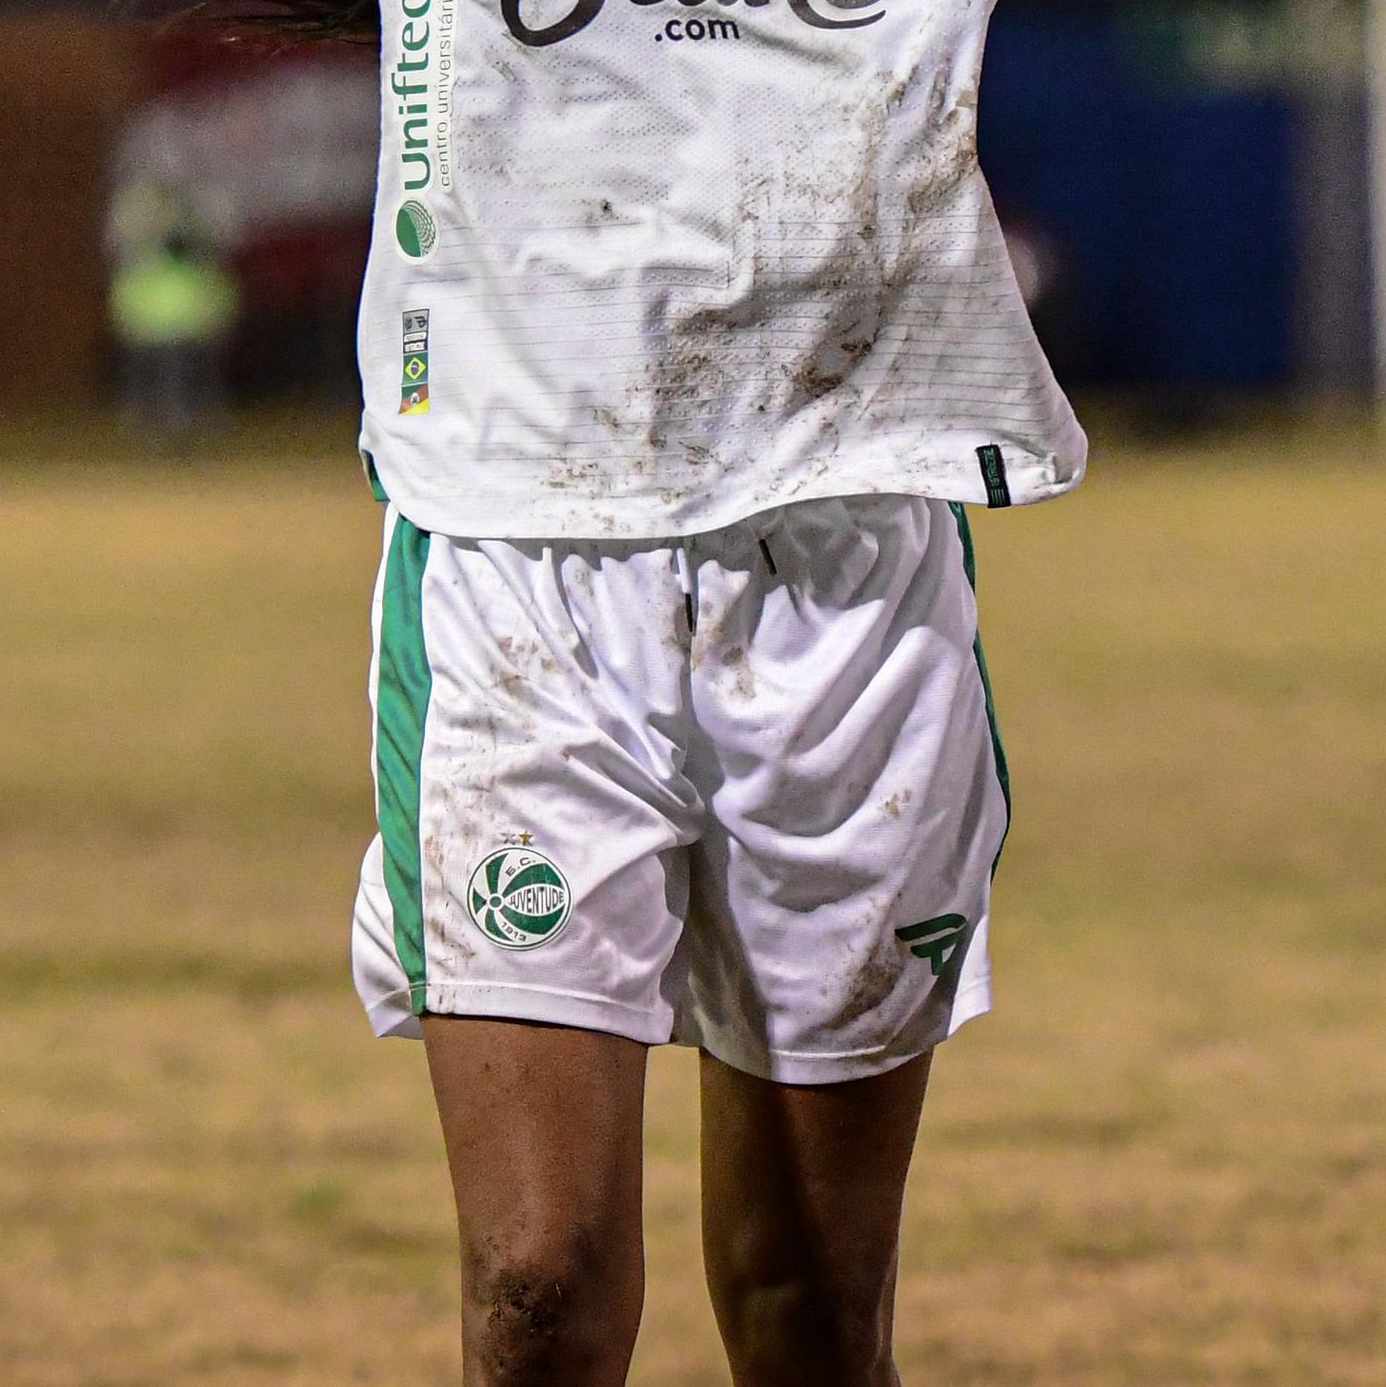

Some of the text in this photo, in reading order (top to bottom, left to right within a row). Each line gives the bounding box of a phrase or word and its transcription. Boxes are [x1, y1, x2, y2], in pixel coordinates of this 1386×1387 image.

[654, 15, 740, 42] .com
[436, 121, 450, 187] centro
[509, 886, 564, 915] JUVENTUDE
[501, 922, 528, 942] 1913
